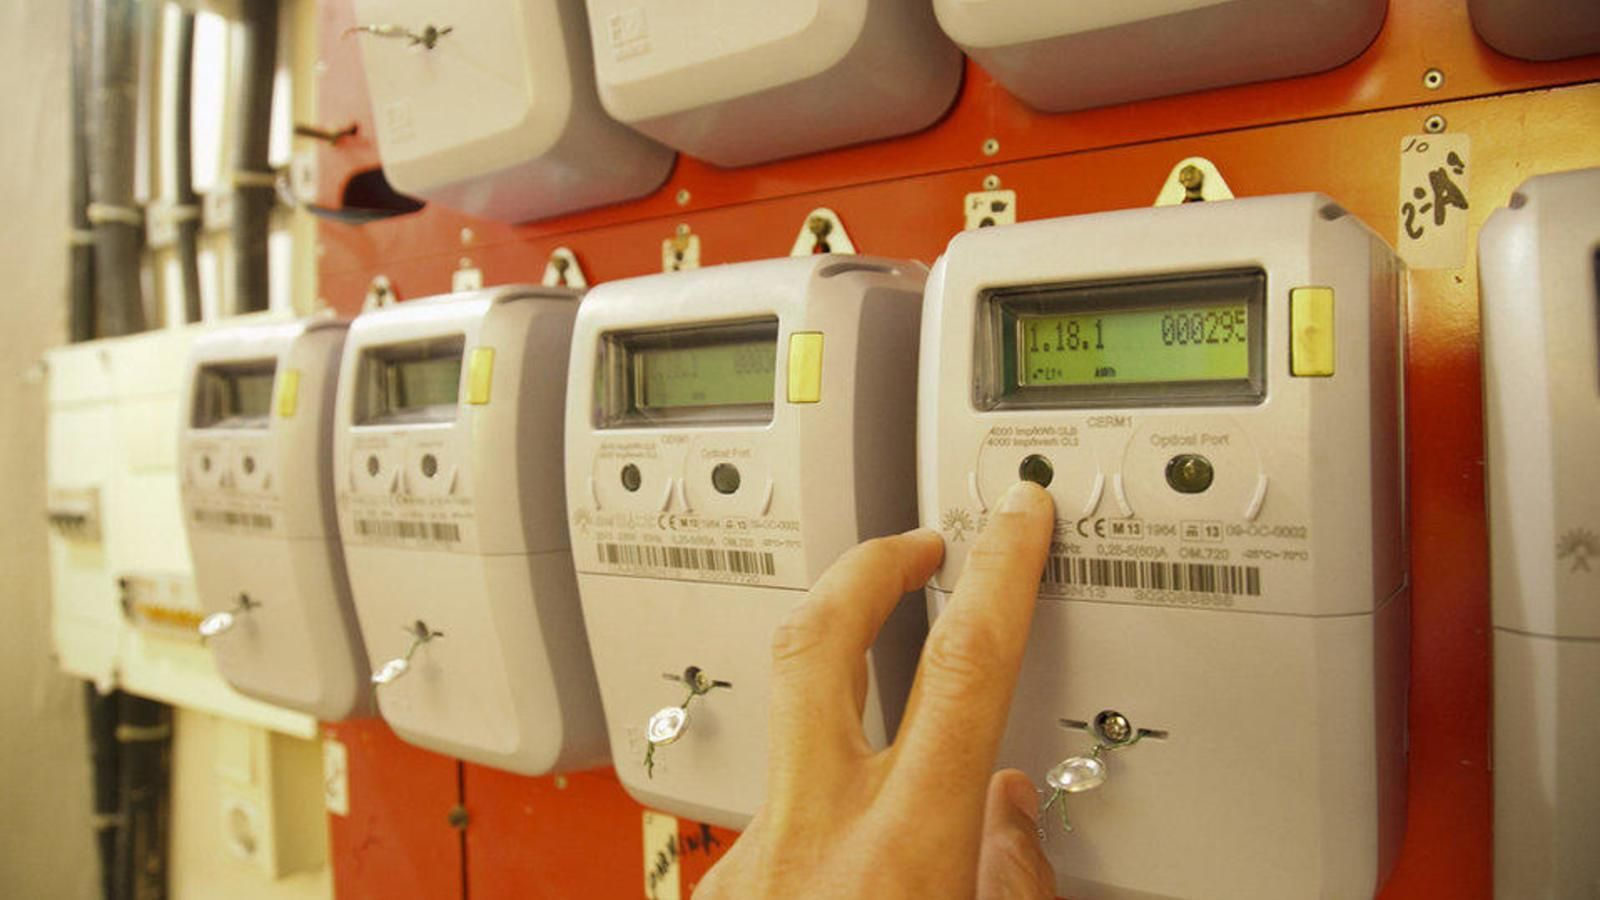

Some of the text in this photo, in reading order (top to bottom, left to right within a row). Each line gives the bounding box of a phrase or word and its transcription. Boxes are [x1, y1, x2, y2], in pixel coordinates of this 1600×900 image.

[1031, 309, 1246, 352] 1.18.1 000295
[1150, 432, 1230, 448] Optical Port
[1127, 523, 1141, 535] 13
